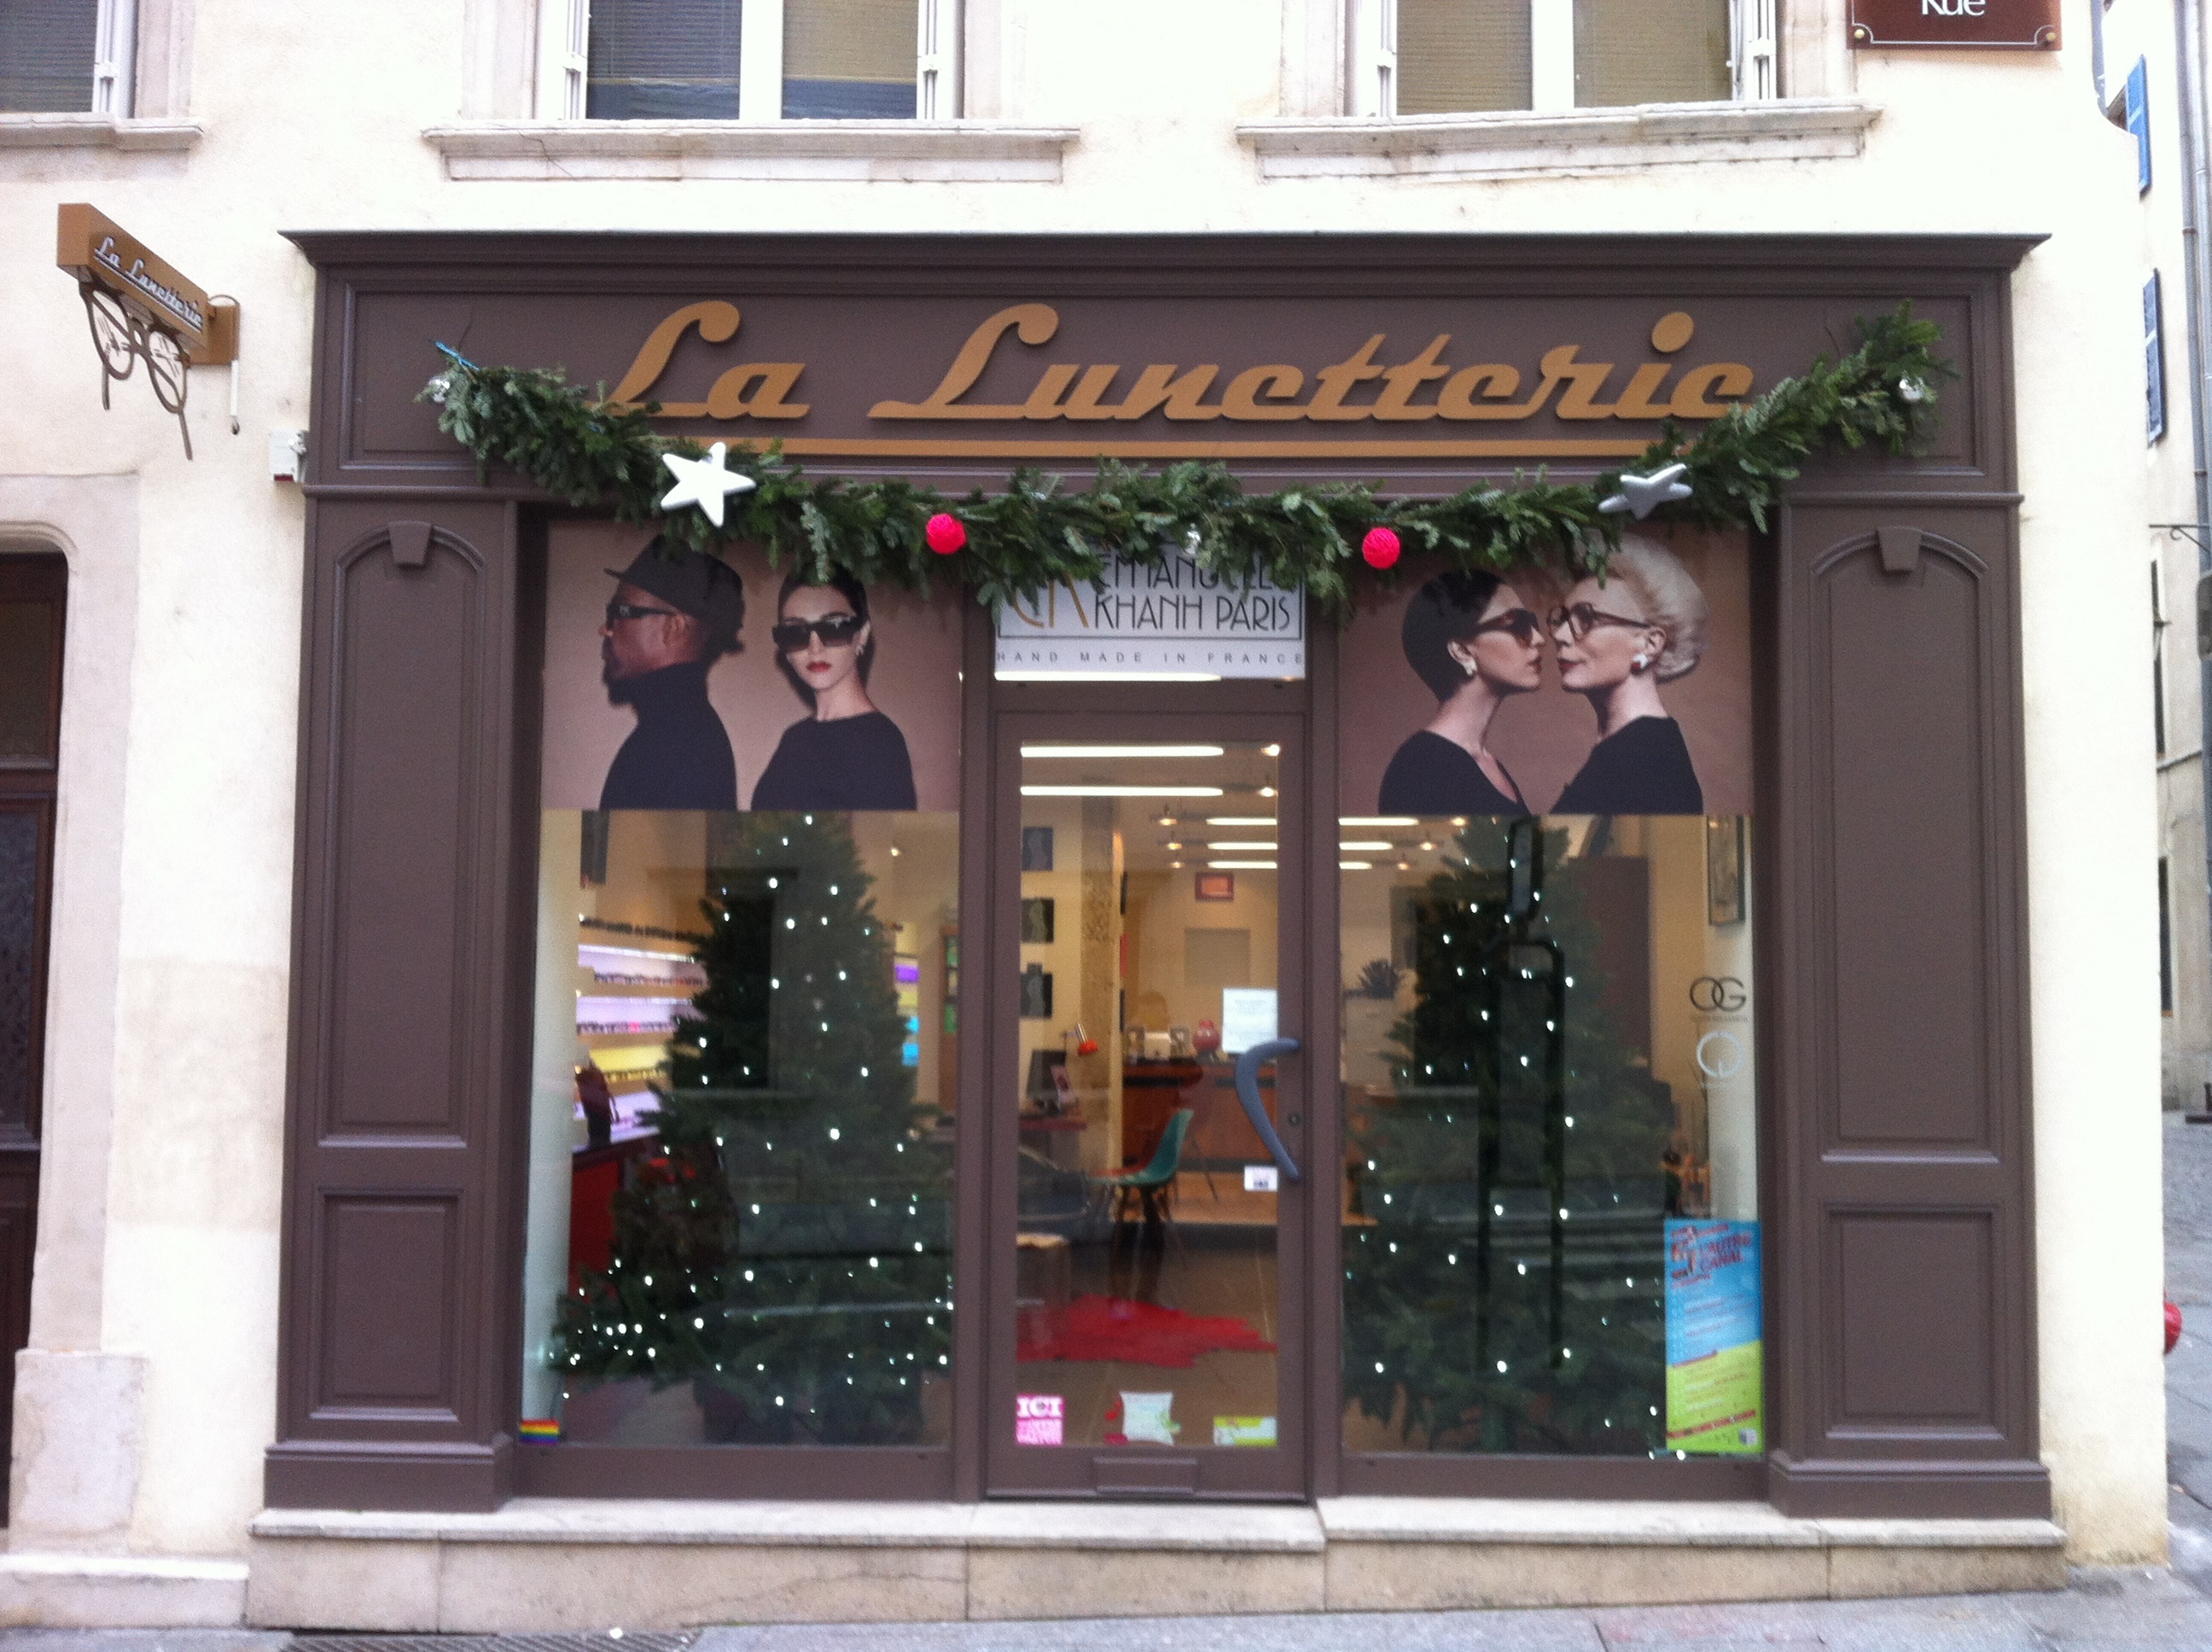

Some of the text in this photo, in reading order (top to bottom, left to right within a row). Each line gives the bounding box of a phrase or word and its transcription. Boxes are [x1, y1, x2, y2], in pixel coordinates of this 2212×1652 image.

[1922, 0, 1986, 15] Rue
[94, 236, 203, 328] La Lunetterie
[584, 300, 1755, 421] La Lunetterie
[1095, 595, 1289, 631] KHANH PARIS
[997, 651, 1302, 665] HAND MADE IN FRANCE
